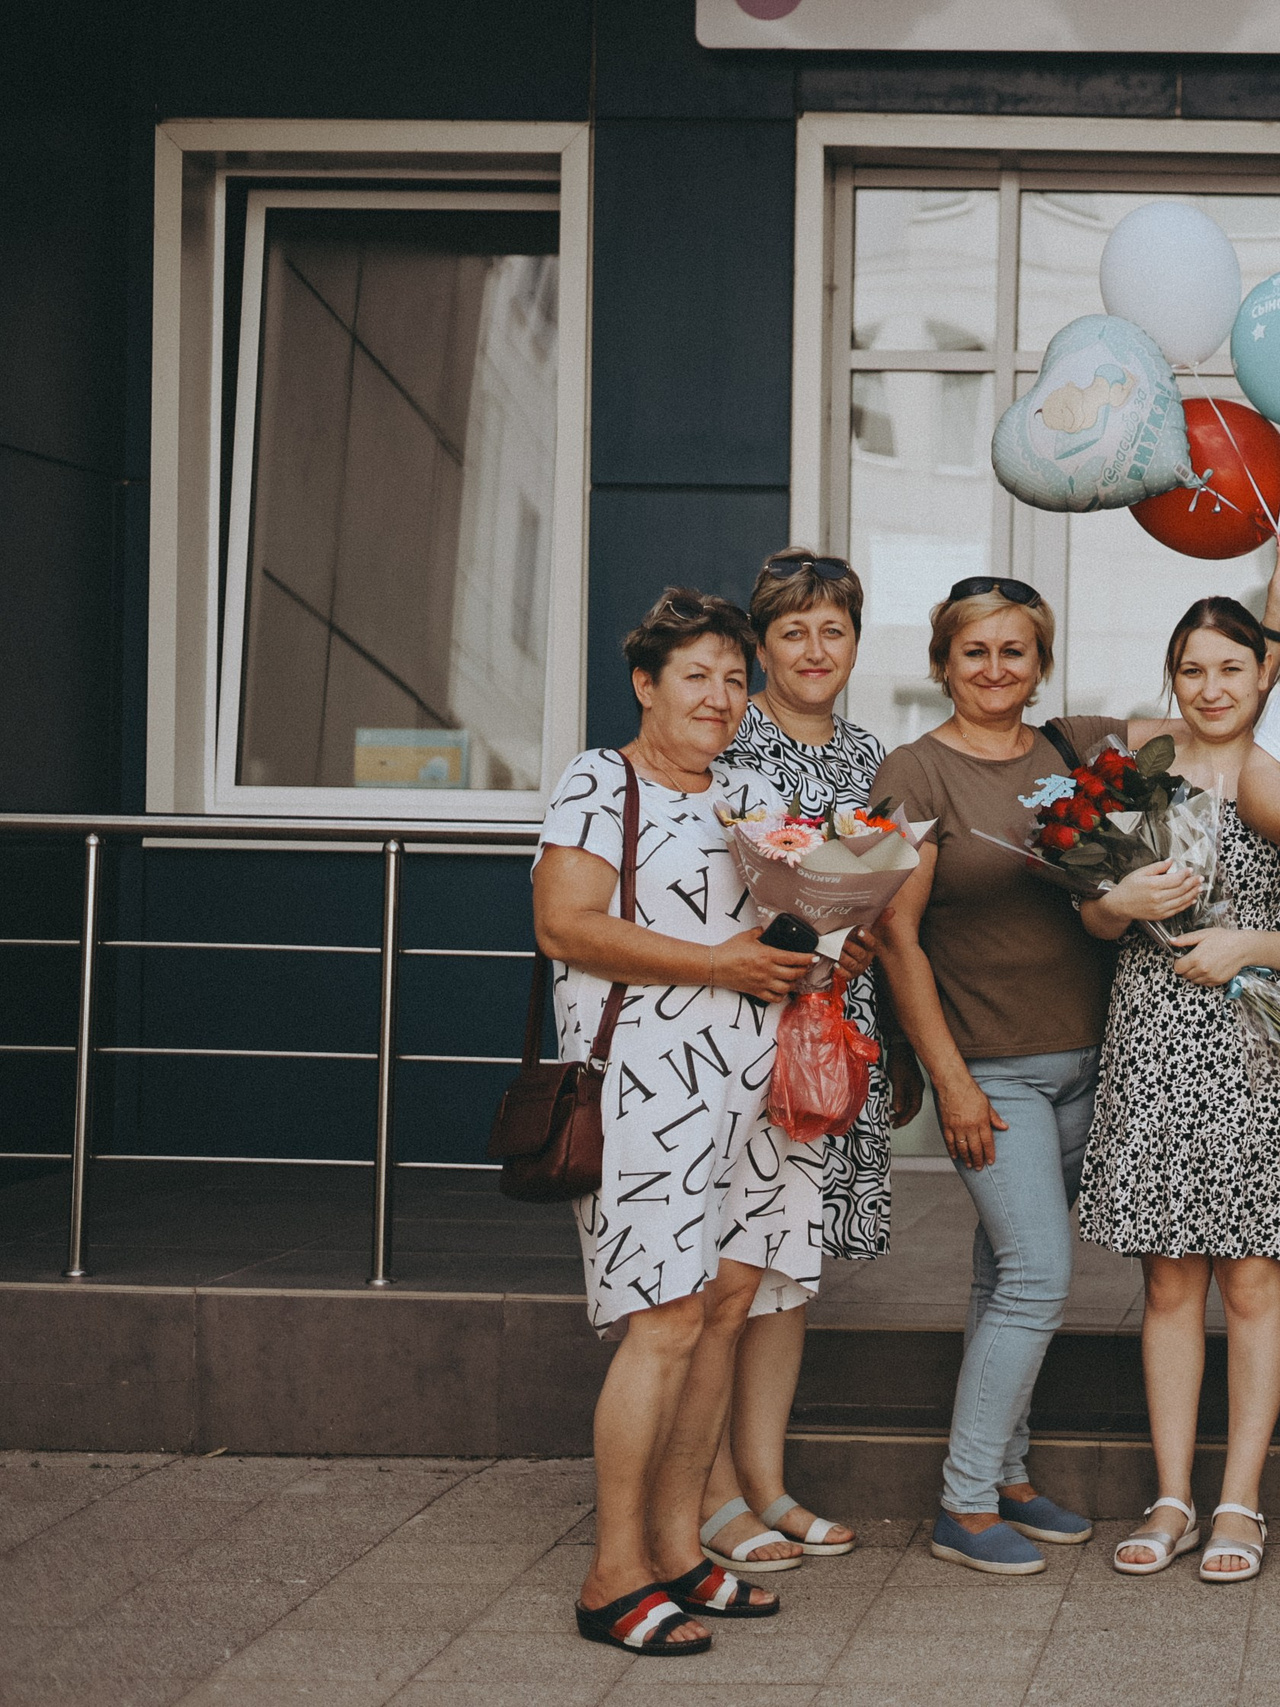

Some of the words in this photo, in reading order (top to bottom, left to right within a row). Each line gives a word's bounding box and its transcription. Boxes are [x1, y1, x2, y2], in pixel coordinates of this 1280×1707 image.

[1103, 410, 1140, 485] Спасибо
[1133, 387, 1148, 410] за
[1126, 380, 1173, 482] ВНУКА!
[796, 867, 842, 883] MAKING
[793, 897, 832, 919] you
